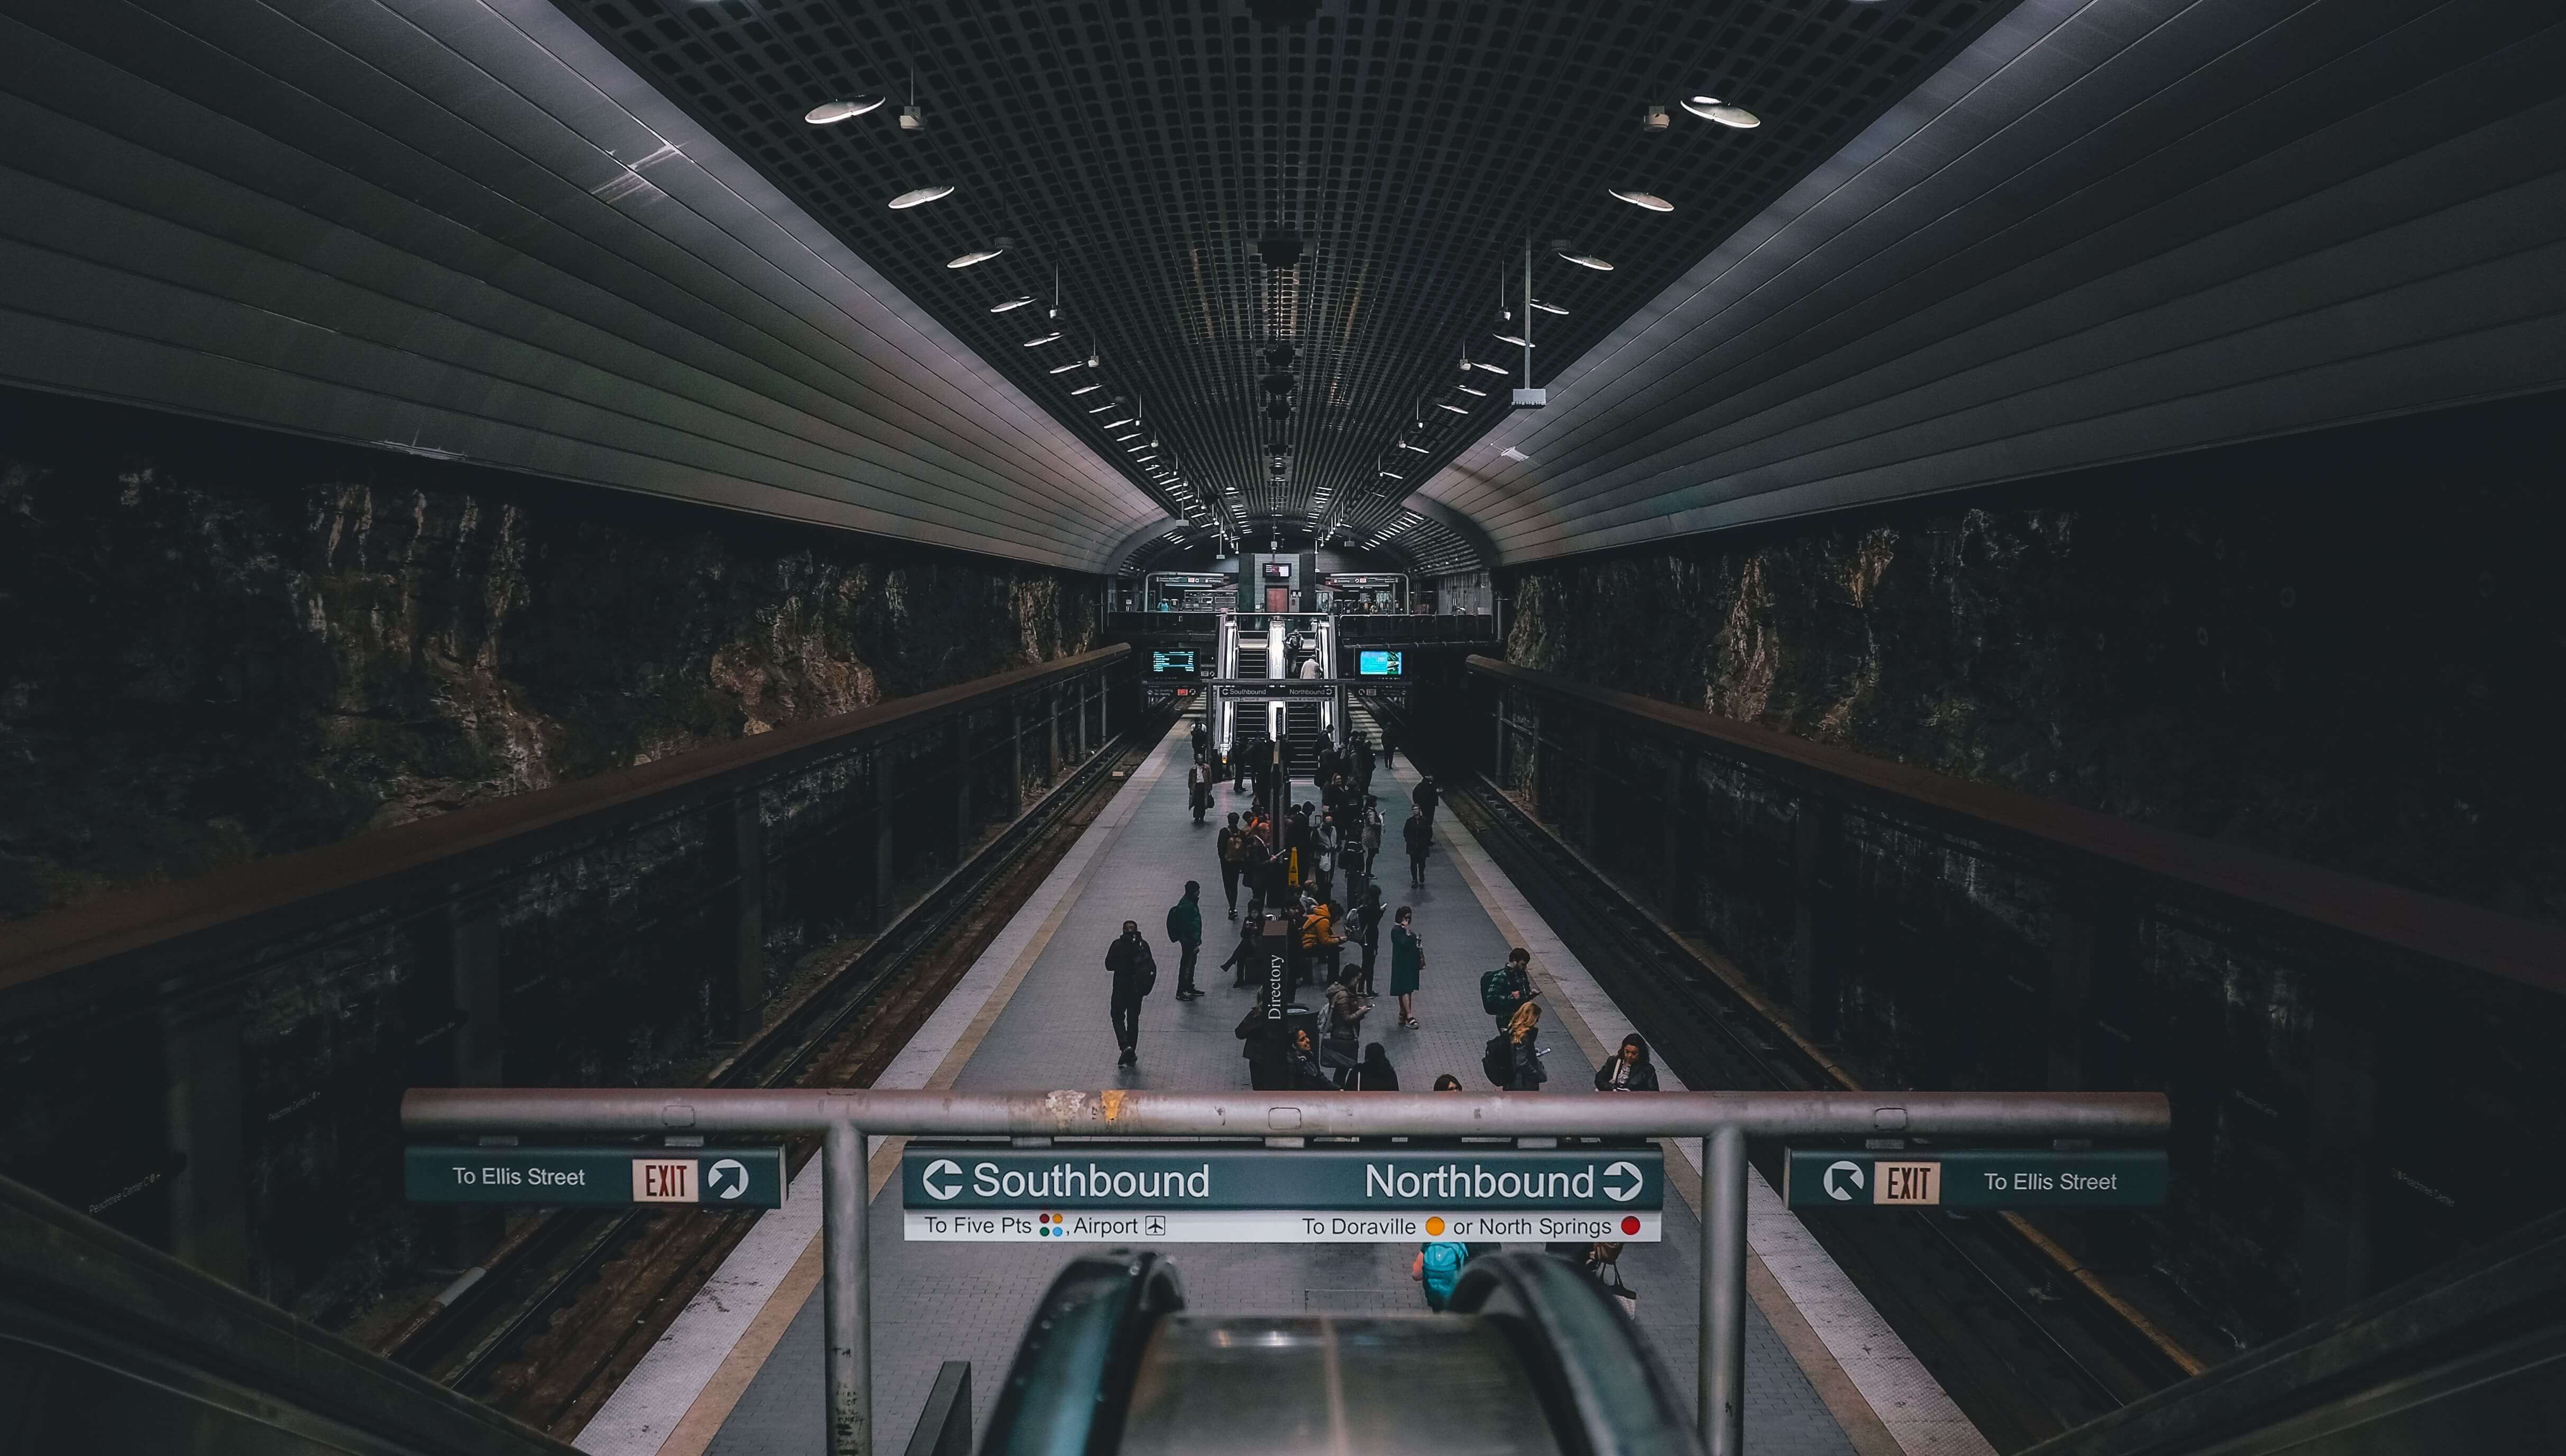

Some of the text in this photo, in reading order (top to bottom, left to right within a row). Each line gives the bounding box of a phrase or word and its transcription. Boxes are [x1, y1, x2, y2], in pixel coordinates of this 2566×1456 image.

[1268, 955, 1284, 1019] Directory
[452, 1167, 585, 1185] To Ellis Street
[645, 1165, 687, 1197] EXIT
[973, 1163, 1209, 1197] Southbound
[1367, 1164, 1593, 1198] Northbound
[1887, 1167, 1931, 1200] EXIT
[1984, 1173, 2117, 1190] To Ellis Street
[924, 1216, 947, 1233] To
[955, 1217, 994, 1233] Five
[1002, 1217, 1032, 1233] Pts
[1302, 1218, 1611, 1239] To Doraville or North Springs
